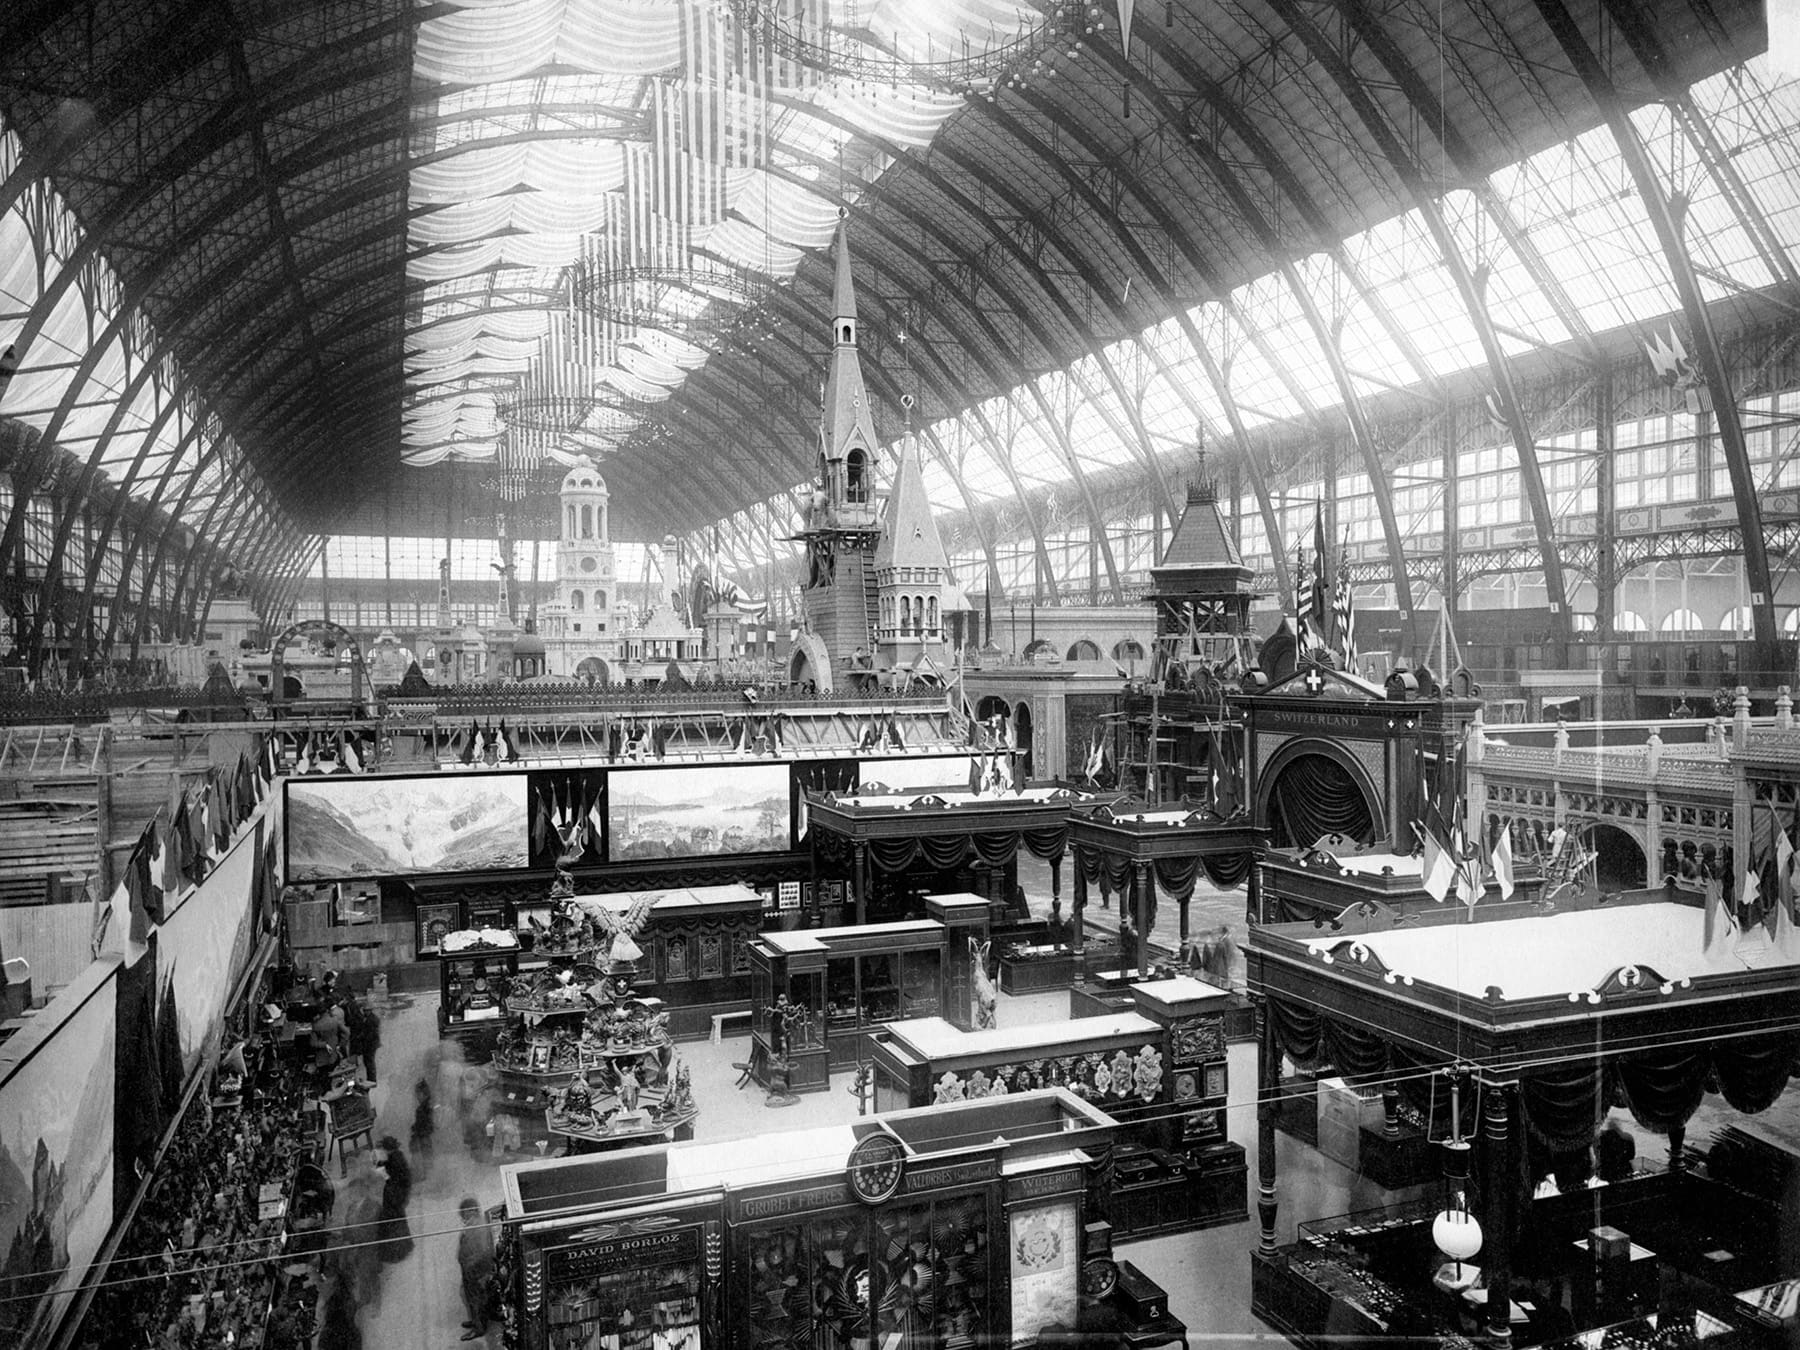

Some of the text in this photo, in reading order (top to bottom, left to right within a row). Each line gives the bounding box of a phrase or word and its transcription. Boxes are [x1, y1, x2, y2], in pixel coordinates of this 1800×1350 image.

[1274, 712, 1359, 727] SWITZERLAND
[745, 1195, 792, 1216] GROBET
[567, 1234, 680, 1260] DAVID BORLOZ
